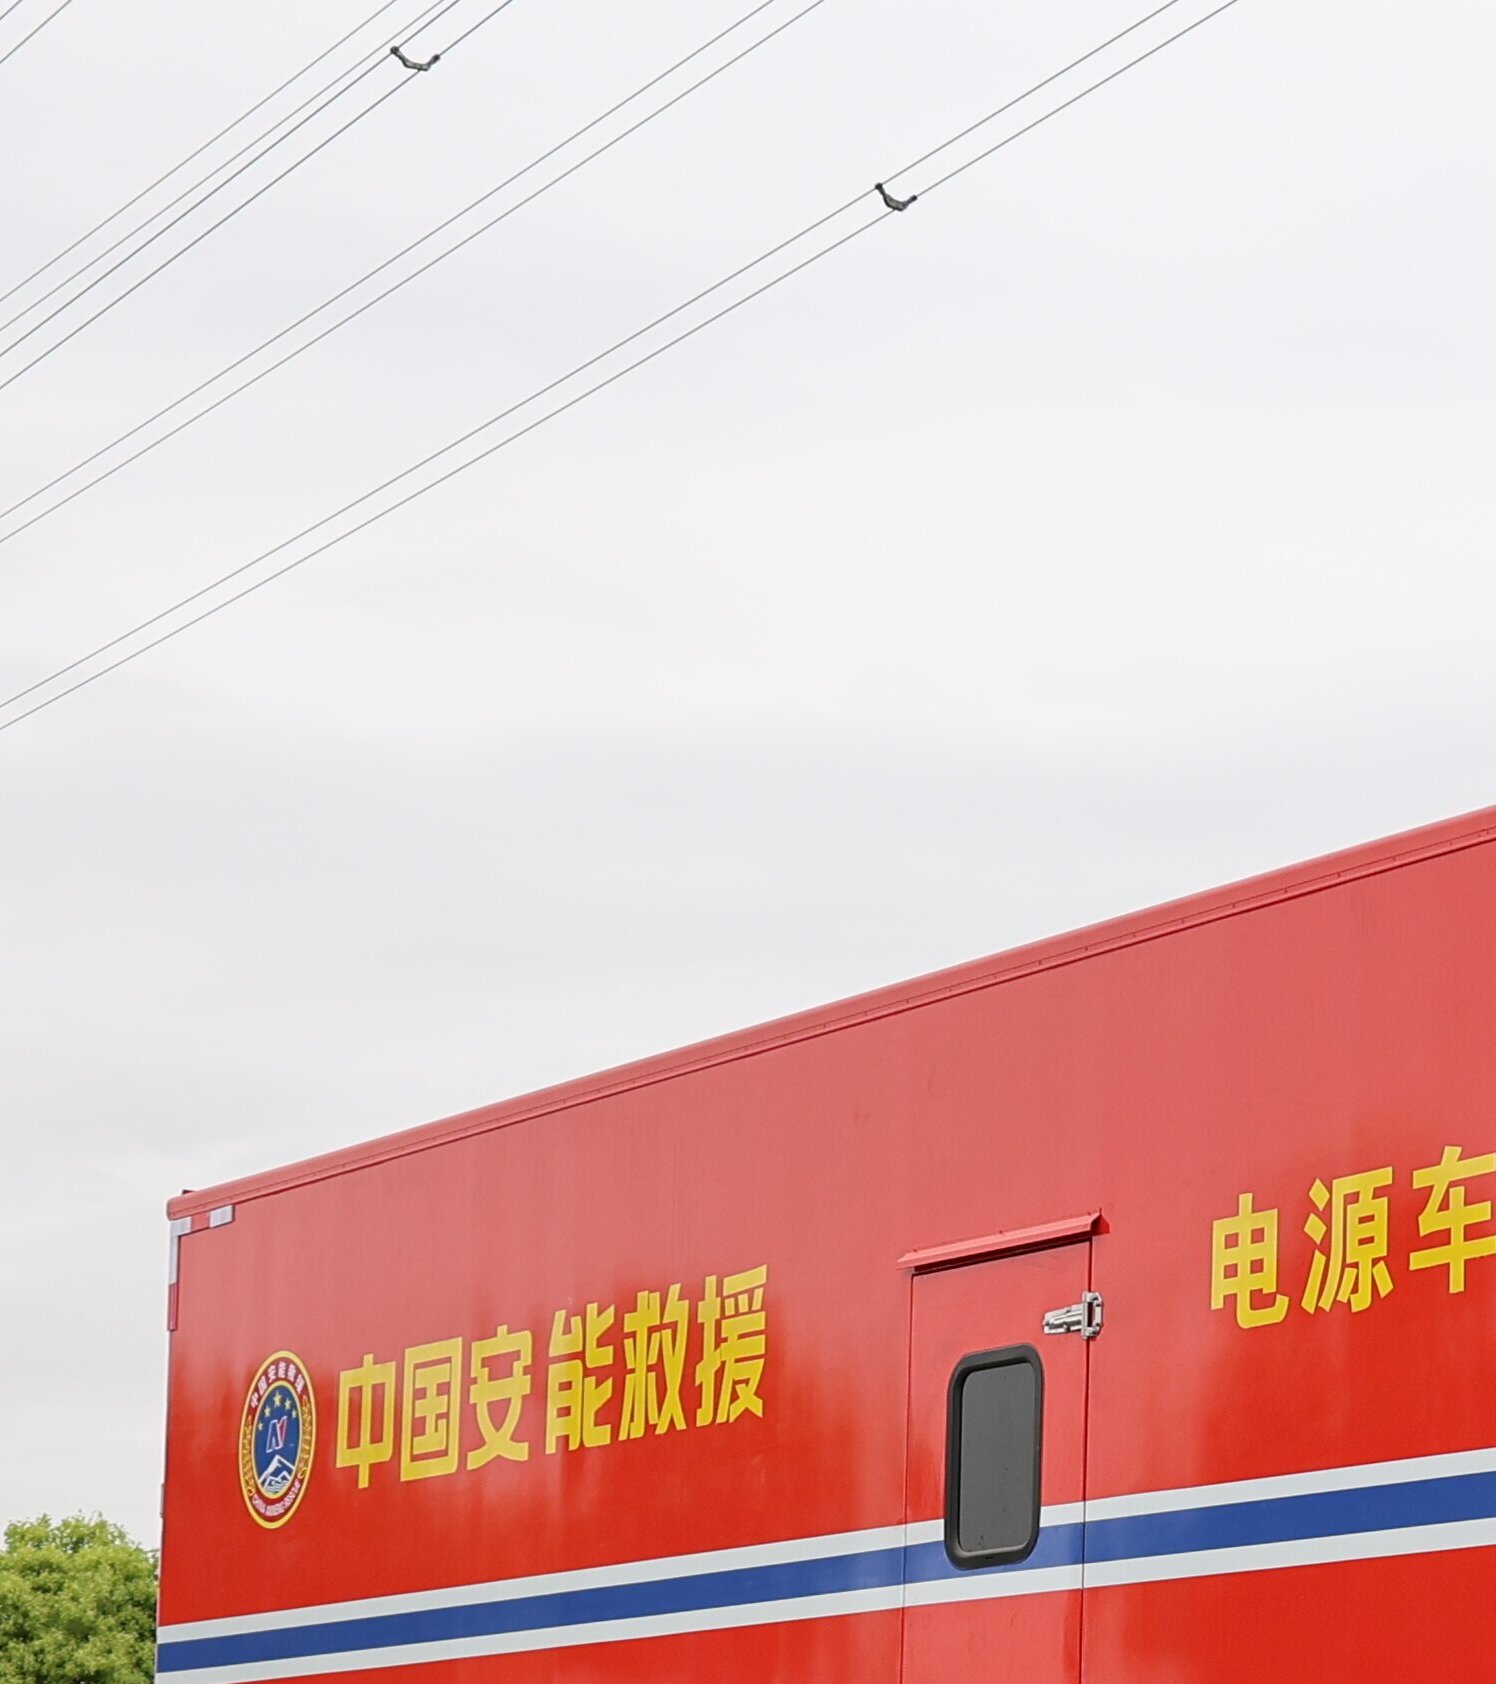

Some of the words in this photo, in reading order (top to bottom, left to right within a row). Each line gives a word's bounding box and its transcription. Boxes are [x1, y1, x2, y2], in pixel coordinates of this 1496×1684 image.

[335, 1264, 767, 1489] 中国安能救援
